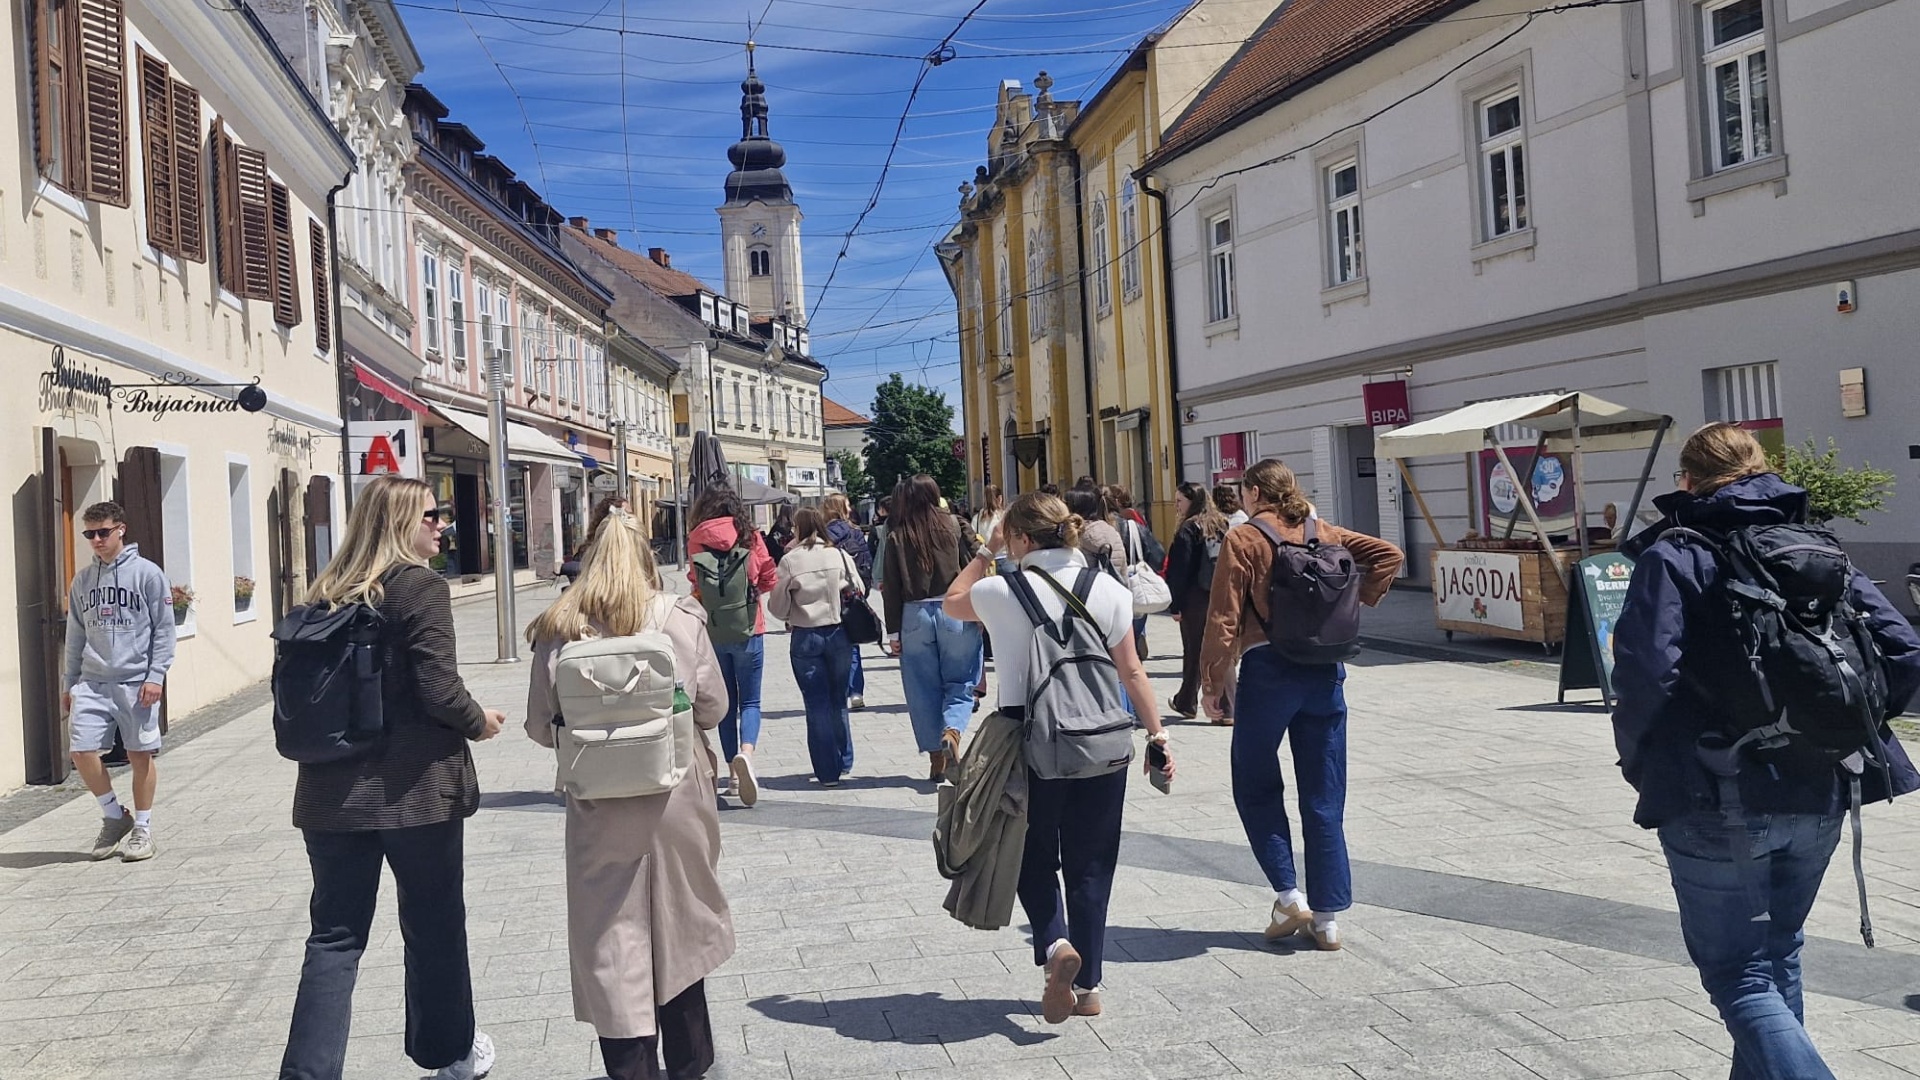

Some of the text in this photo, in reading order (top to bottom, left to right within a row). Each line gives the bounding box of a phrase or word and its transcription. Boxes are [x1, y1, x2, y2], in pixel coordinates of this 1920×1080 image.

[123, 389, 239, 422] Brijačnica
[1371, 407, 1407, 424] BIPA
[366, 428, 407, 474] A1
[1221, 457, 1238, 470] BIPA
[1439, 565, 1522, 604] JAGODA
[80, 586, 141, 613] LONDON
[87, 618, 133, 628] ENGLAND
